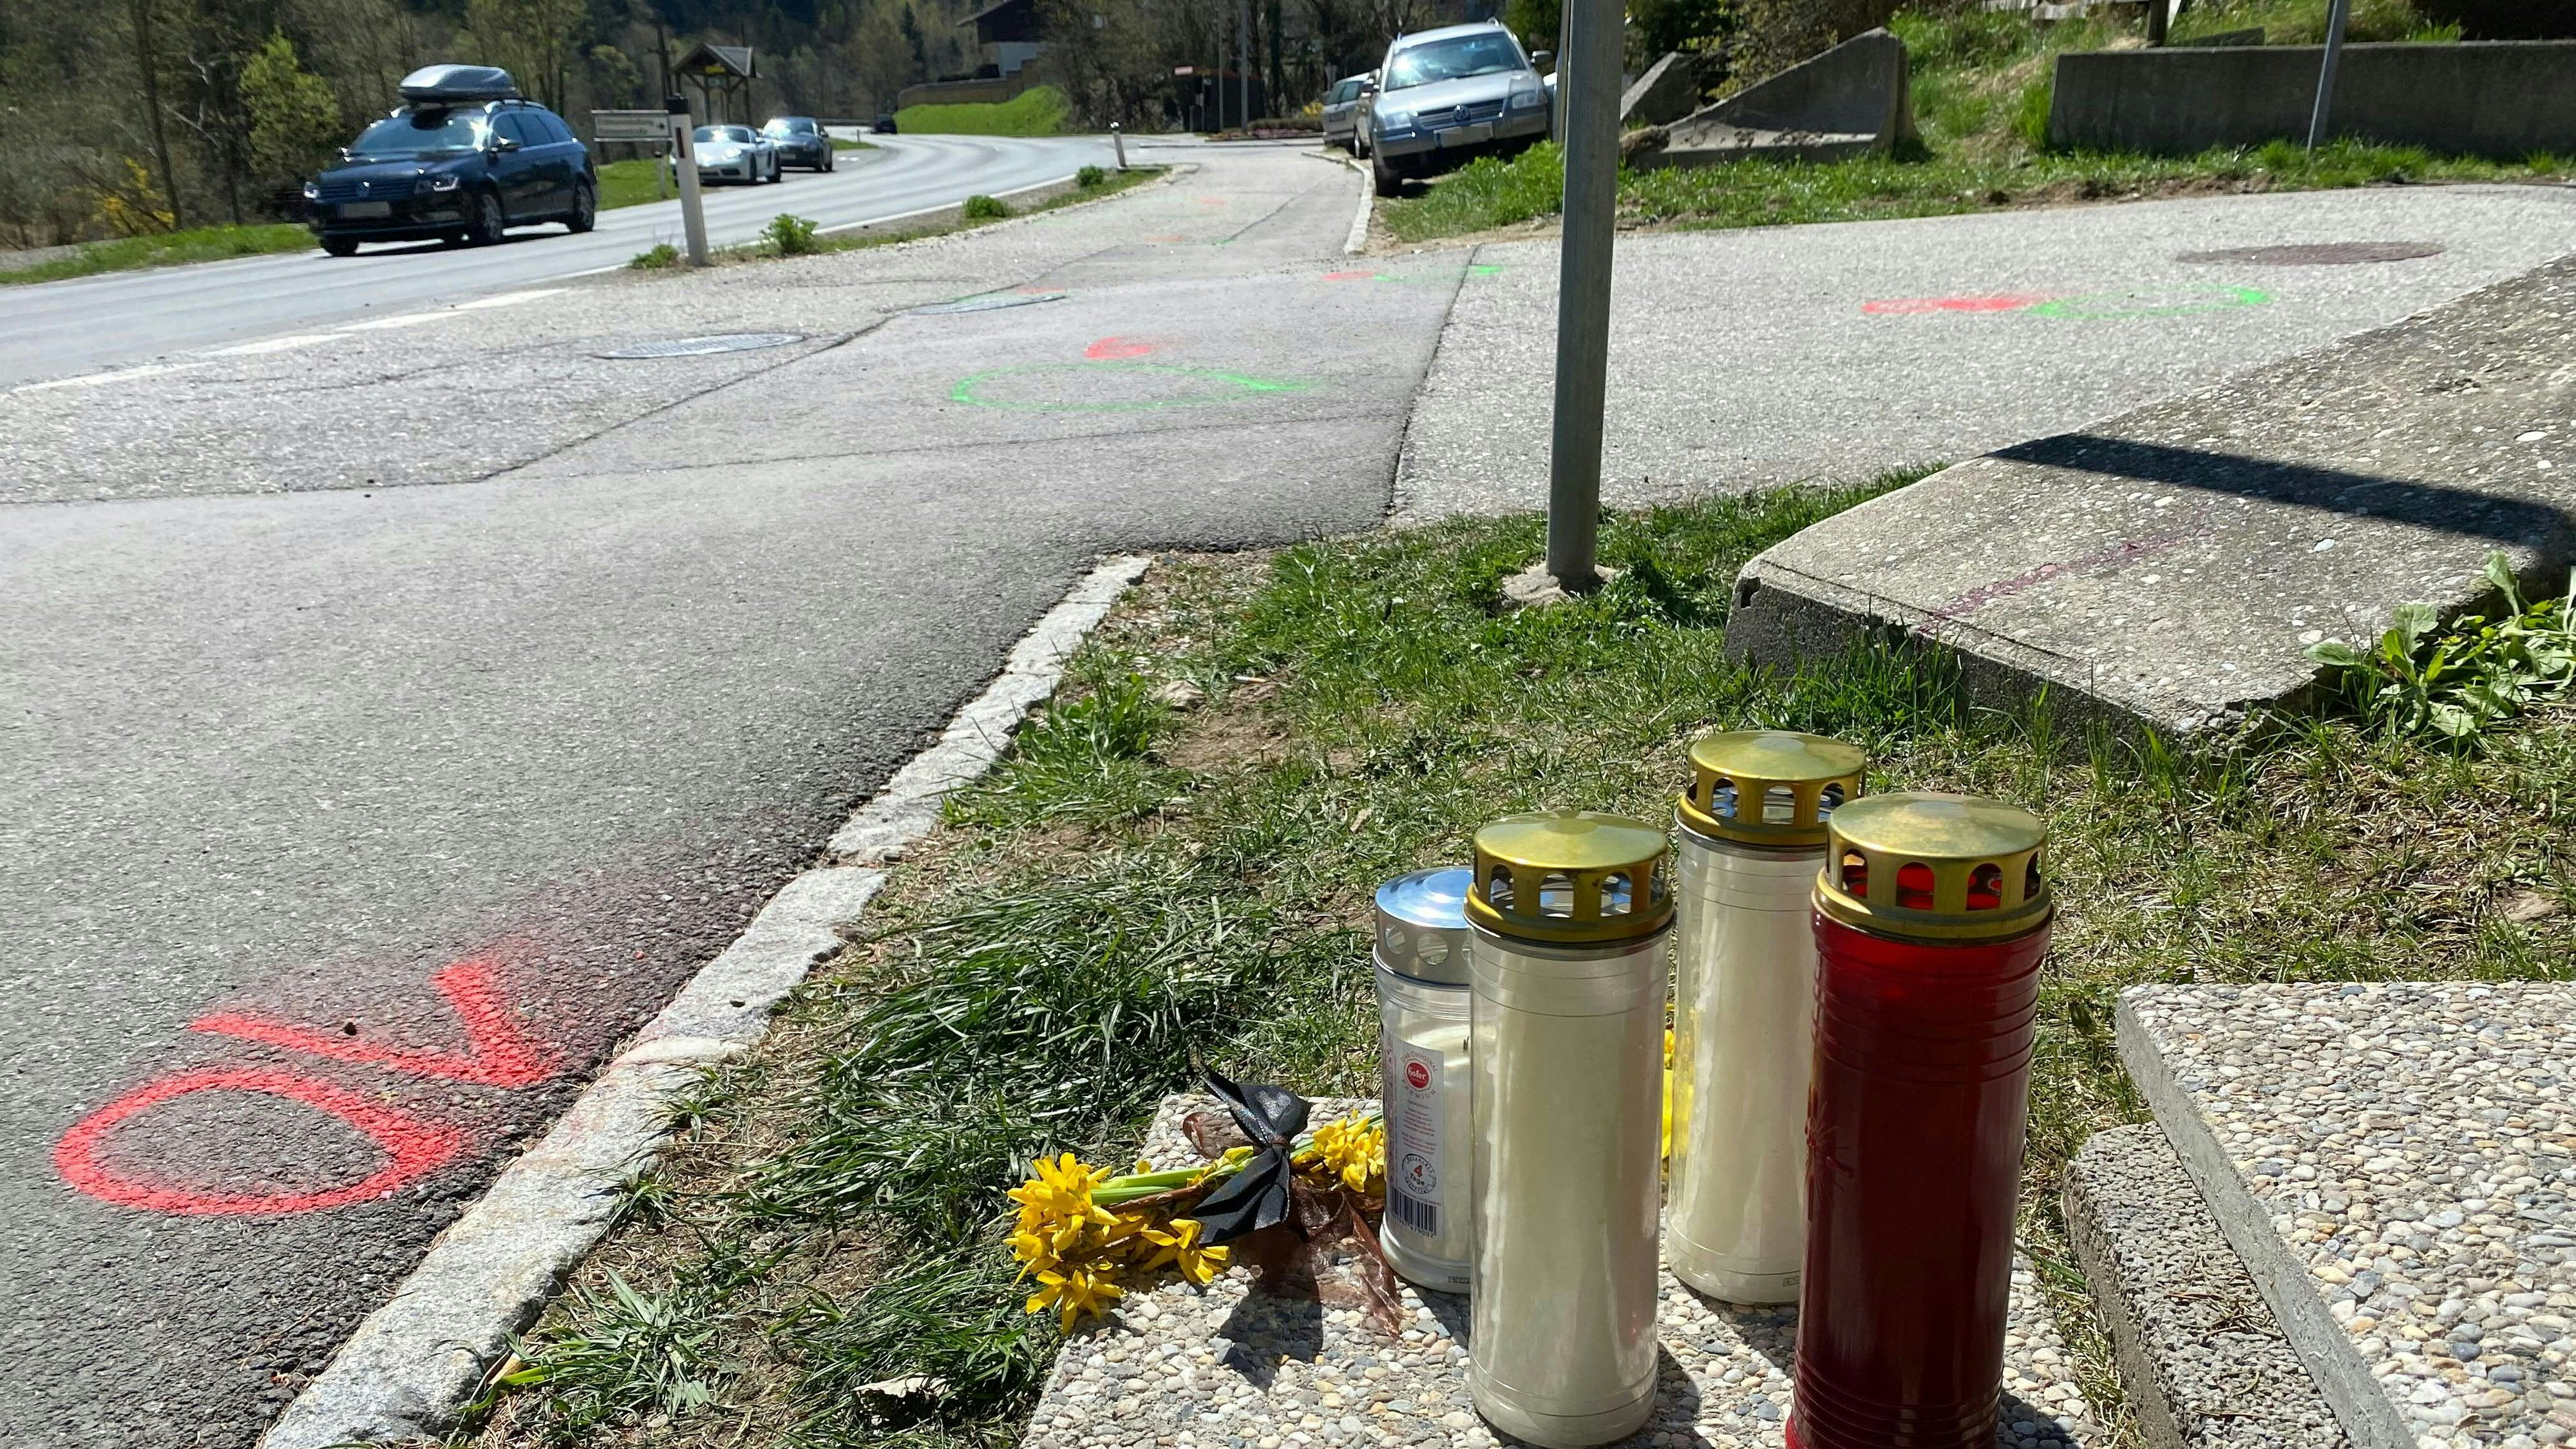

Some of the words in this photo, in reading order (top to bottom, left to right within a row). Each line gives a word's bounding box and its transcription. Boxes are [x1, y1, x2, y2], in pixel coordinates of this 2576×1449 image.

[1410, 1050, 1438, 1074] ORIGINAL
[1401, 1078, 1437, 1101] PREMIUM
[1409, 1172, 1425, 1186] Tage
[1414, 1164, 1423, 1179] 4
